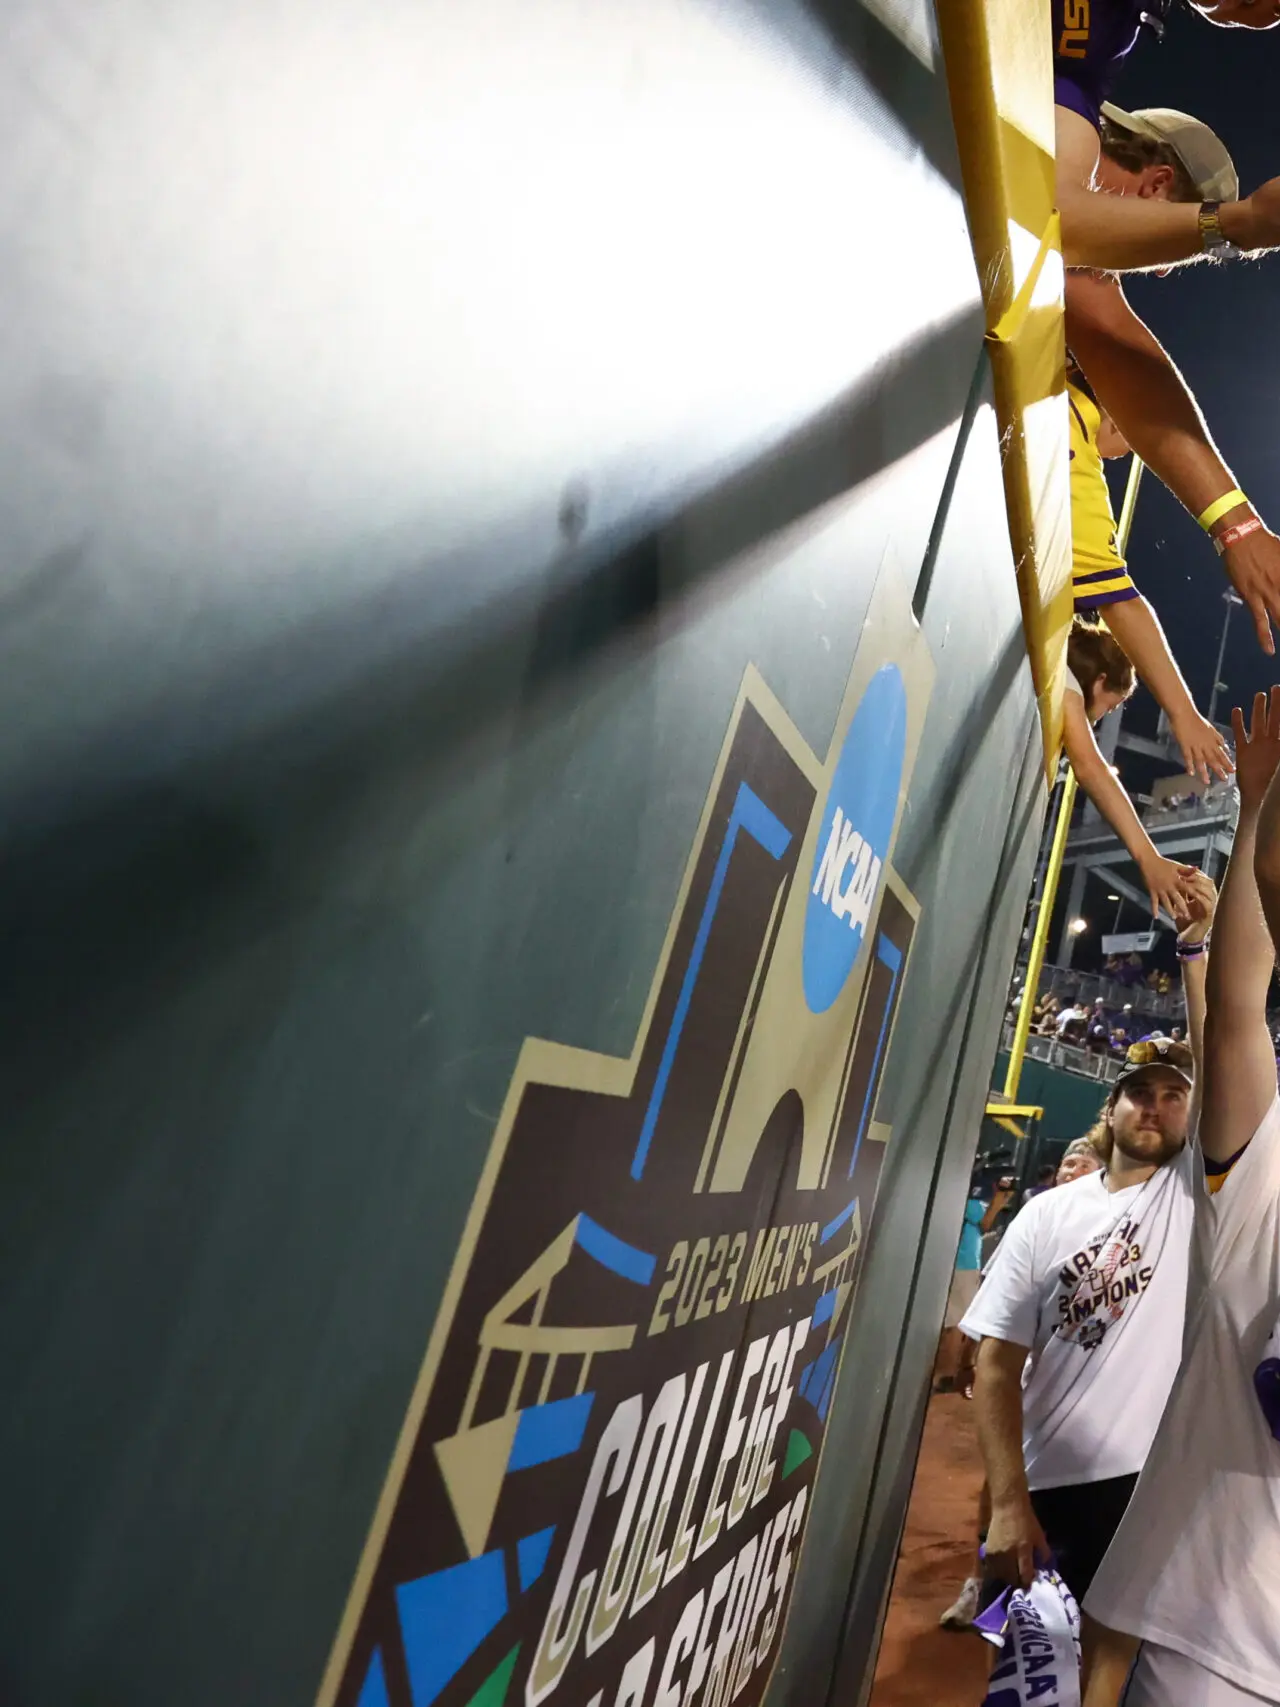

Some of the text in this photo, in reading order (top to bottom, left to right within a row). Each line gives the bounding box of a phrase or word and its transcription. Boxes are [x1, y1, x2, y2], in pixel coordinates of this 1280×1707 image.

[812, 806, 882, 940] NCAA
[647, 1221, 820, 1338] 2023 MEN'S
[525, 1316, 813, 1707] COLLEGE
[1019, 1628, 1058, 1702] NCAA
